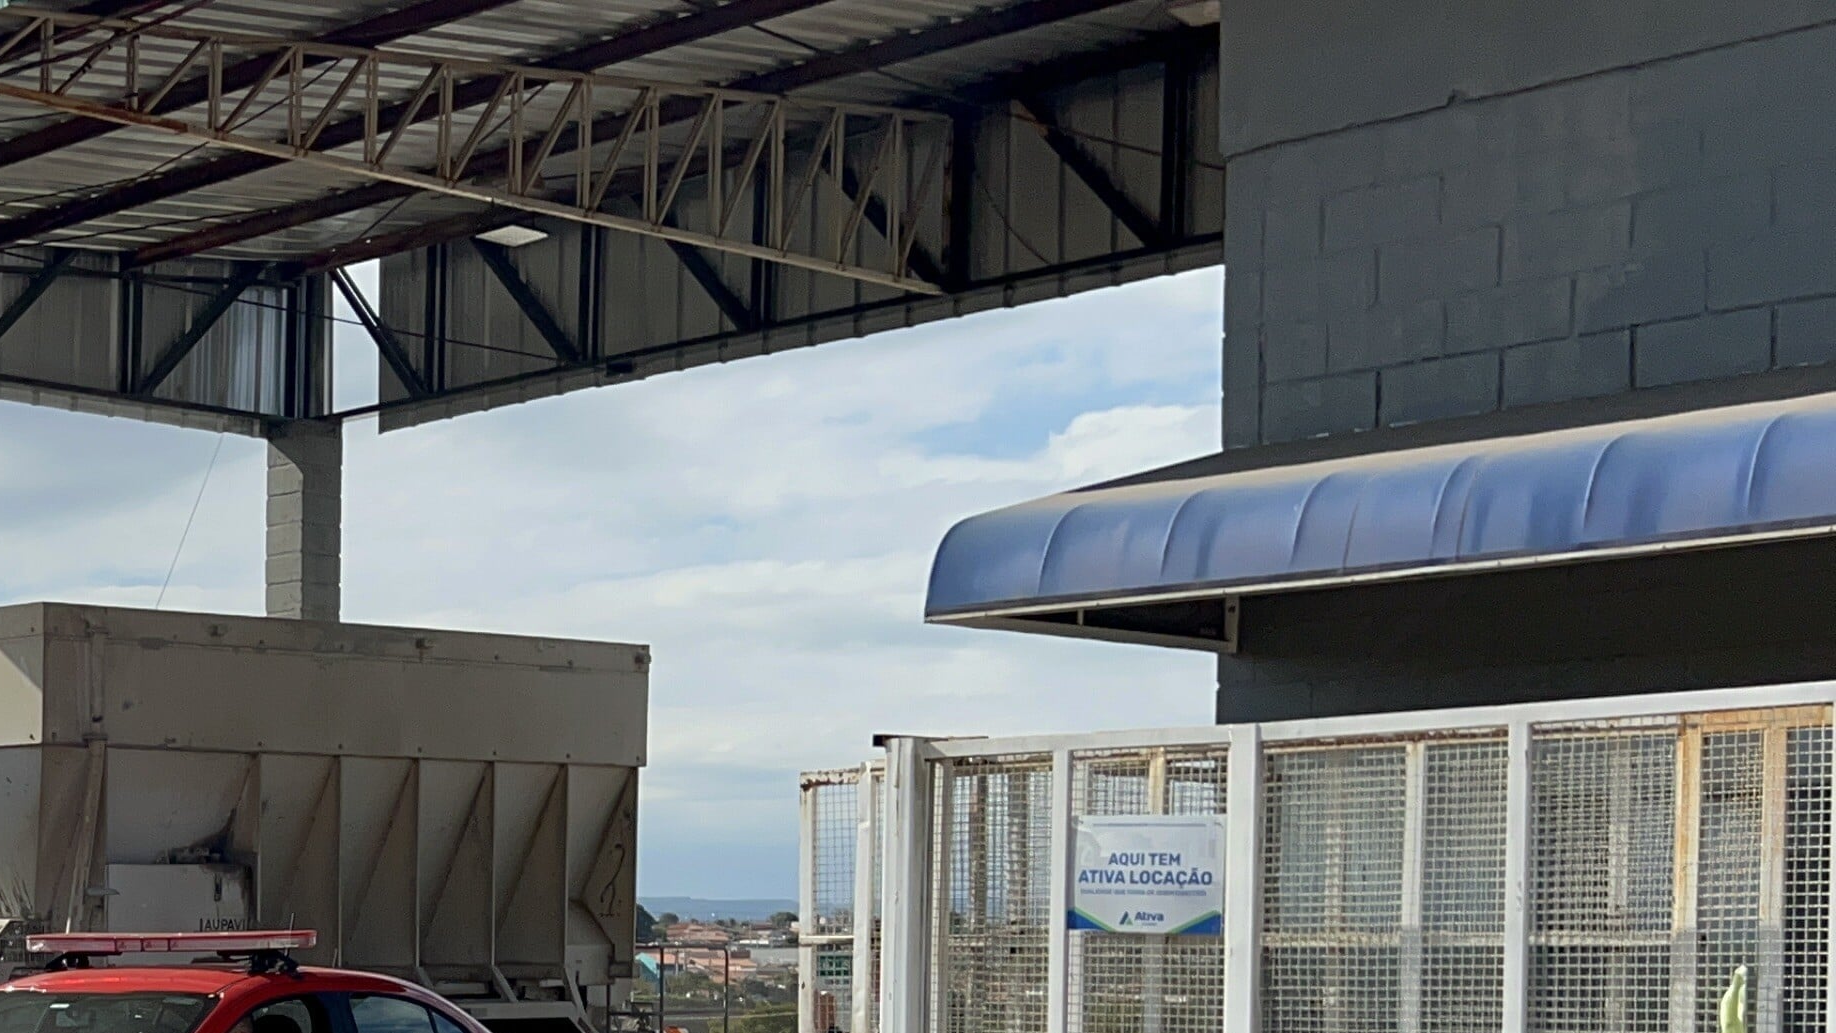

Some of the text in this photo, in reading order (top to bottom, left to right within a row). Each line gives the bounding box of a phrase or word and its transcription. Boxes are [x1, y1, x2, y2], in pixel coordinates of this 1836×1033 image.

[1108, 853, 1181, 867] AQUI TEM
[1078, 867, 1213, 889] ATIVA LOCAÇÃO
[1134, 911, 1165, 922] Ativa
